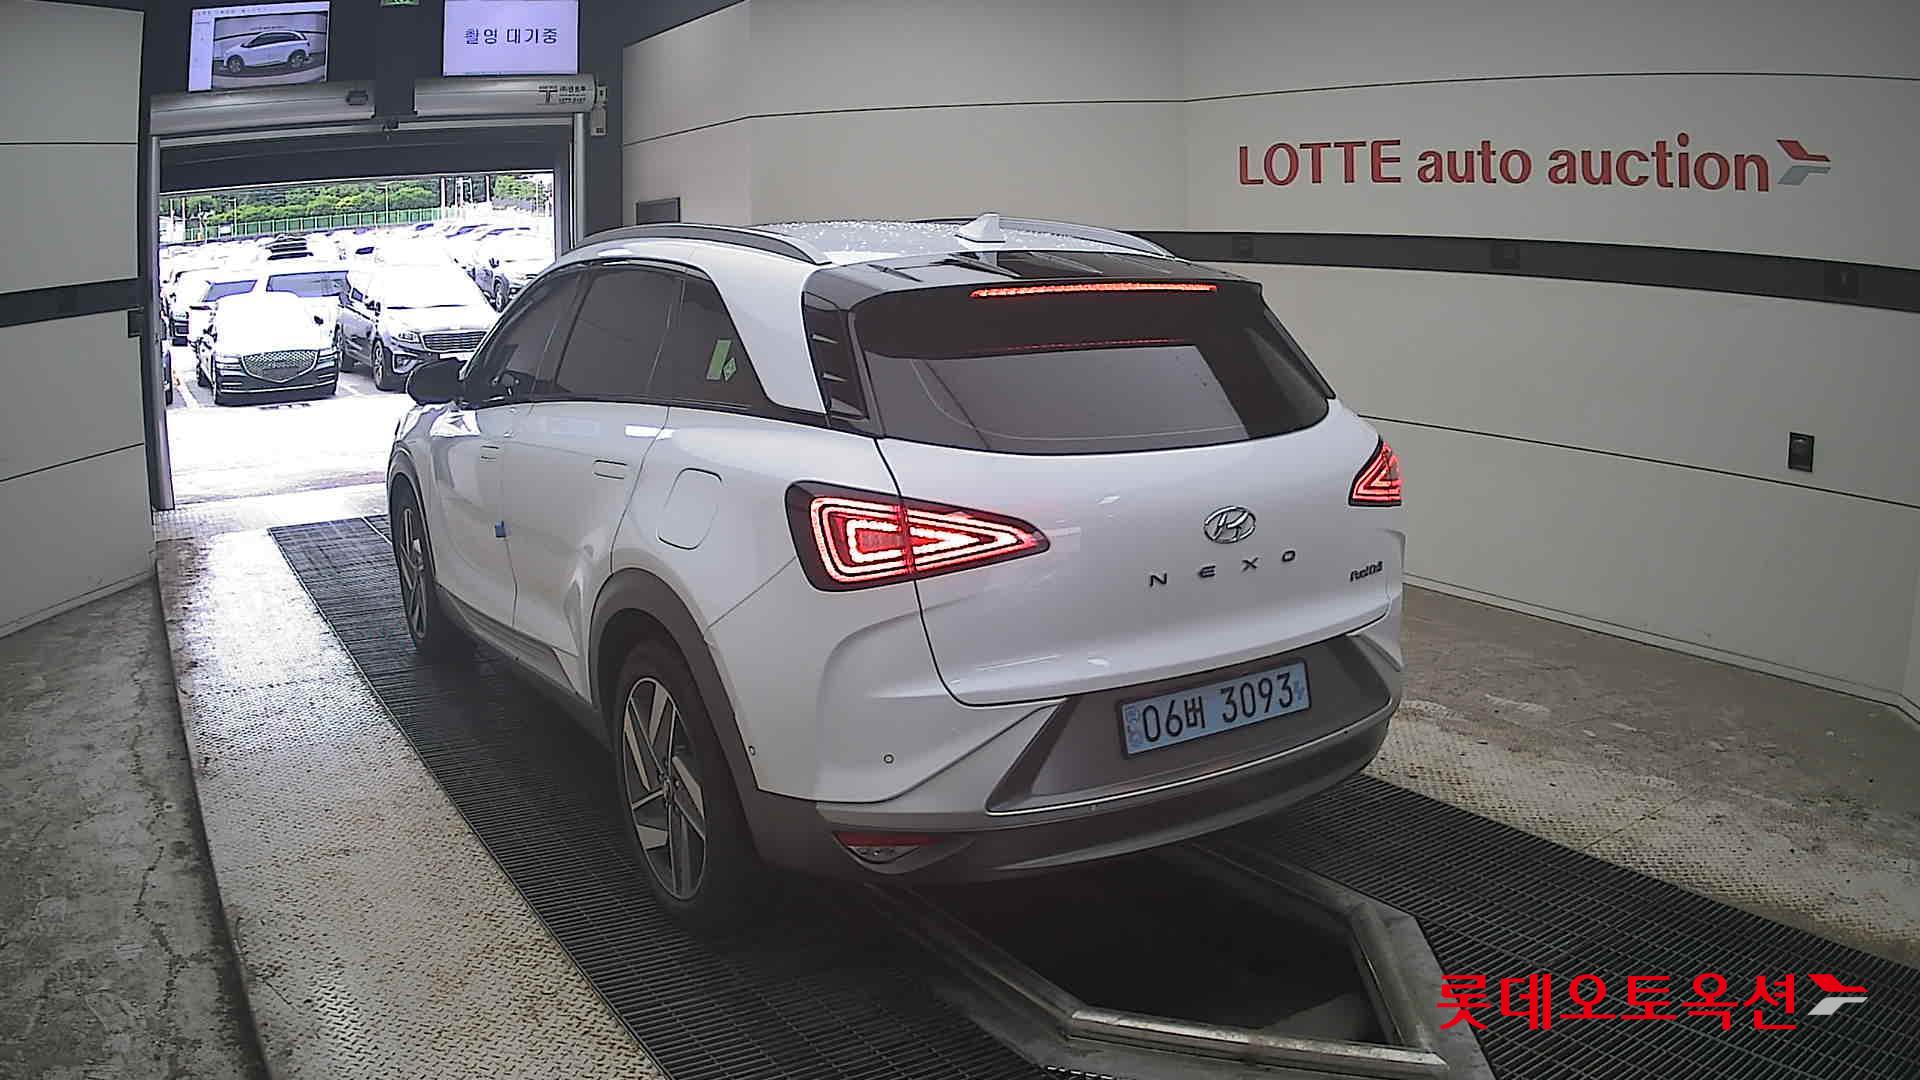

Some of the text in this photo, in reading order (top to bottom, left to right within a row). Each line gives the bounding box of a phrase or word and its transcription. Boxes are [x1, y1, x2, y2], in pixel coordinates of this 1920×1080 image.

[506, 28, 558, 45] 대기중
[1238, 132, 1771, 193] LOTTE auto auction
[1148, 550, 1297, 588] NEXO
[1142, 671, 1294, 743] 06버 3093
